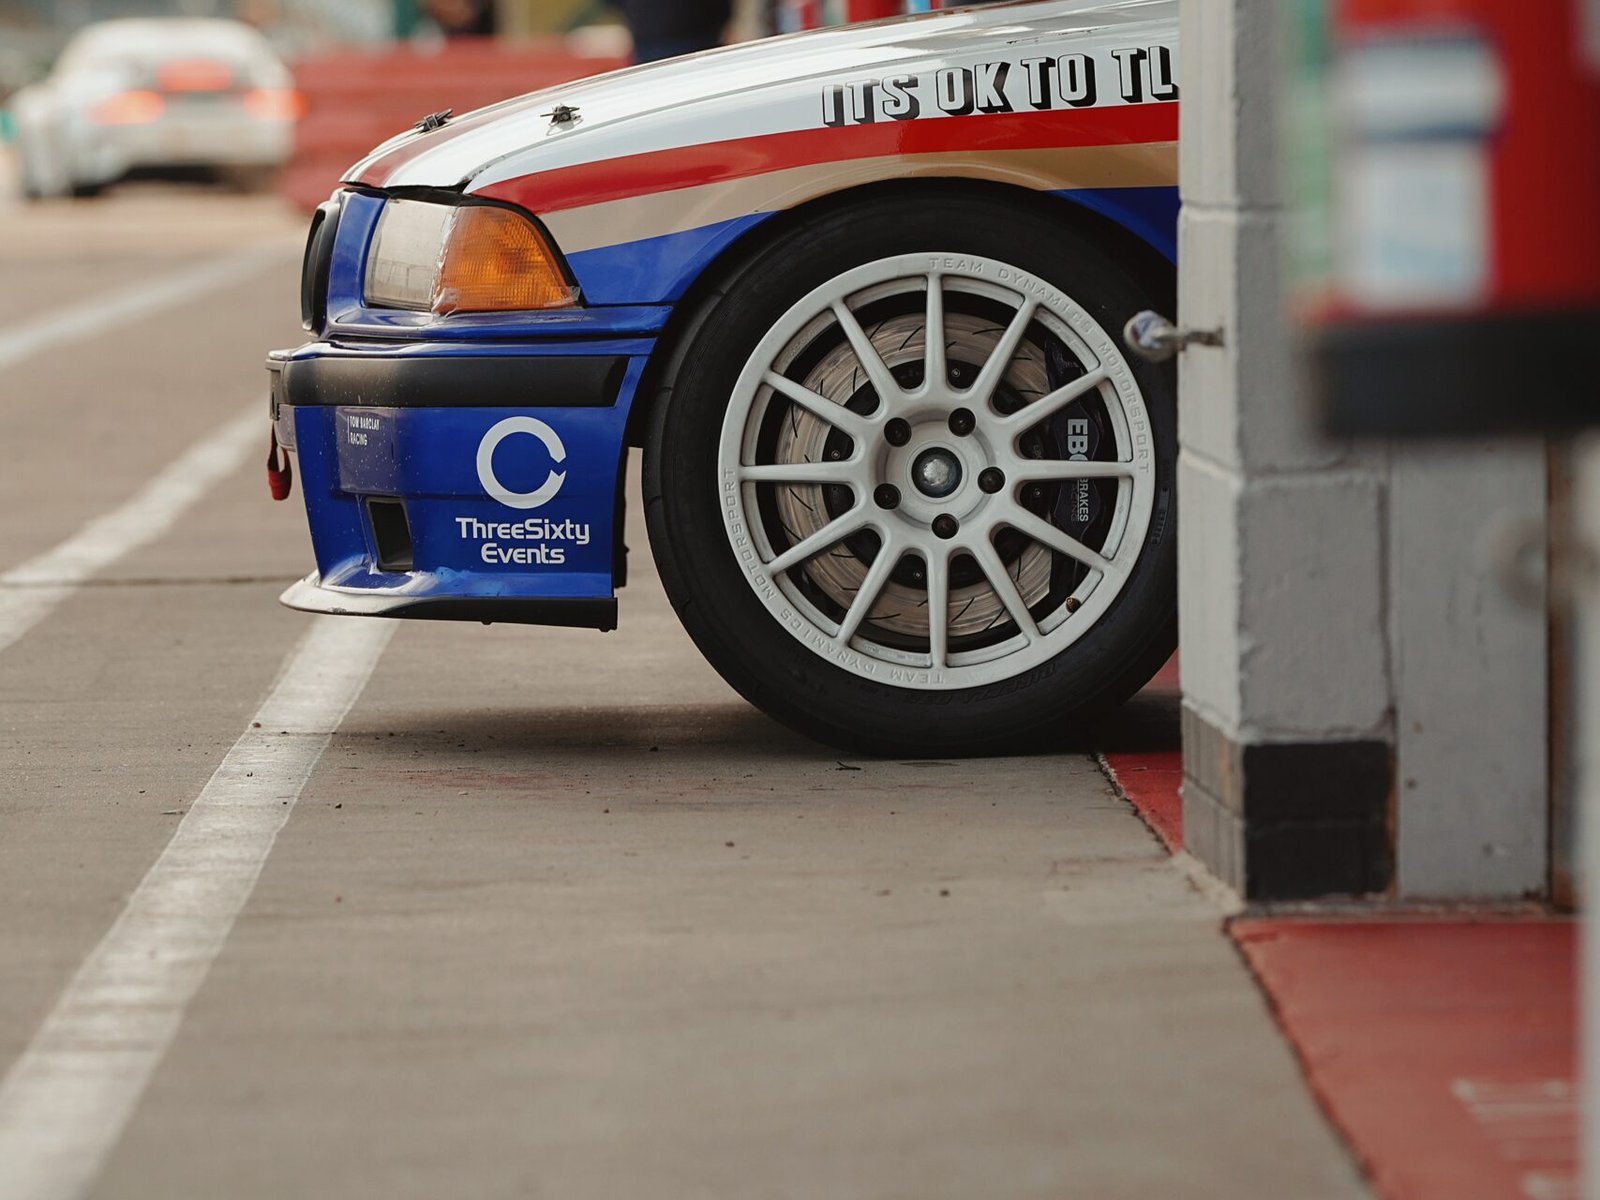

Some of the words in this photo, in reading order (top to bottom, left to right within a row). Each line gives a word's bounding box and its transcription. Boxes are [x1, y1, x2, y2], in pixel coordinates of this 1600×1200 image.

[822, 74, 919, 127] ITS
[936, 61, 1013, 116] OK
[1020, 53, 1096, 111] TO
[928, 257, 984, 274] TEAM
[997, 267, 1095, 335] DYNAMICS
[1097, 341, 1150, 473] MOTORSPORT
[350, 432, 367, 445] RACING
[1079, 478, 1089, 522] BRAKES
[455, 517, 590, 544] ThreeSixty
[723, 467, 775, 601] MOTORSPORT
[480, 543, 566, 565] Events
[778, 607, 876, 675] DYNAMICS
[889, 669, 944, 685] TEAM
